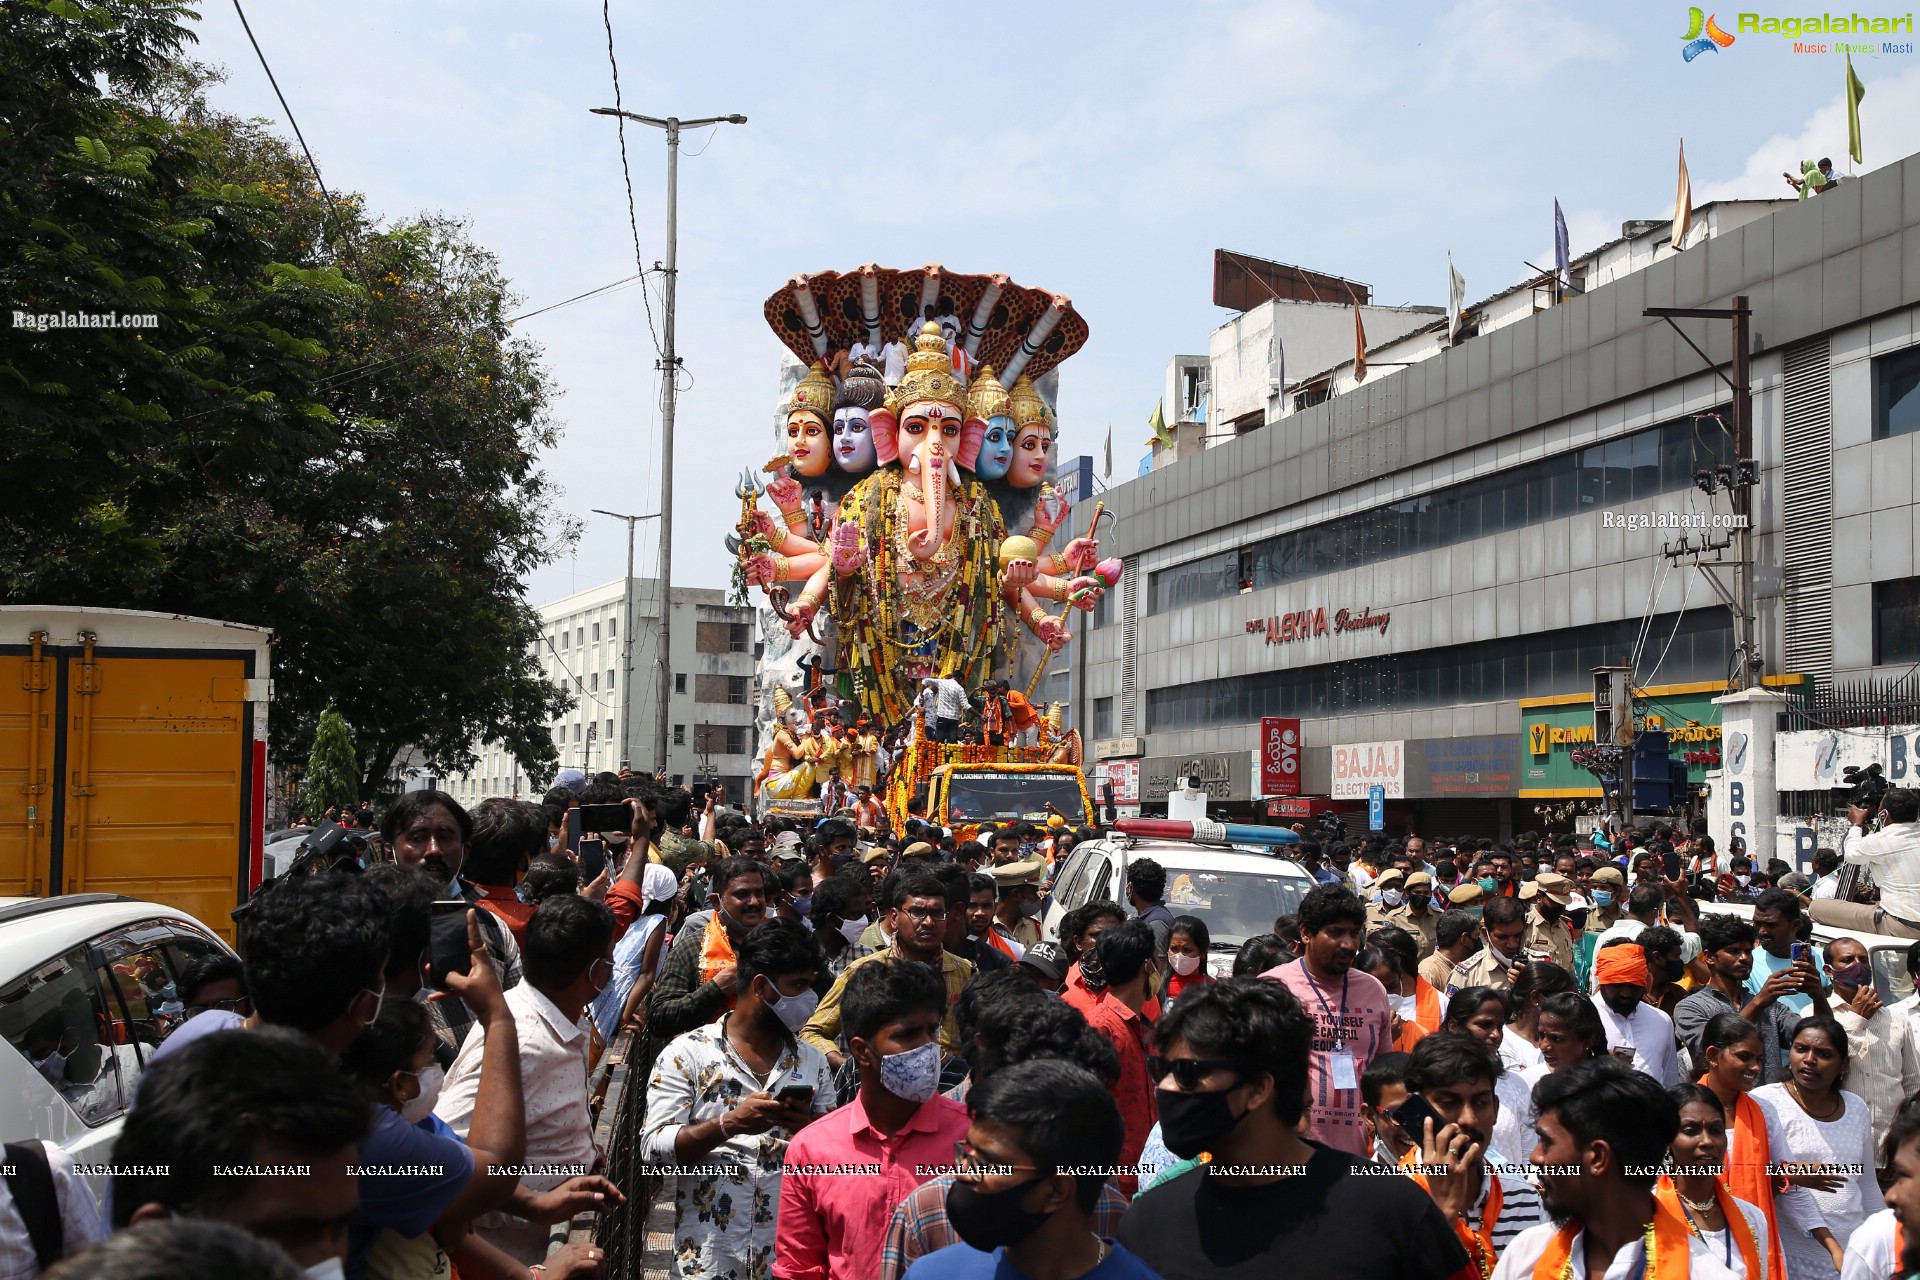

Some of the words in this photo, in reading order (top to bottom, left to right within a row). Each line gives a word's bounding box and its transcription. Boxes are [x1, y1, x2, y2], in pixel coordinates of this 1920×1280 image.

[1265, 607, 1329, 645] ALEKHYA
[1550, 726, 1596, 743] RAM
[1282, 729, 1297, 774] OYO
[1335, 746, 1399, 778] BAJAJ
[1335, 782, 1400, 795] ELECTRICS
[1372, 801, 1380, 820] P
